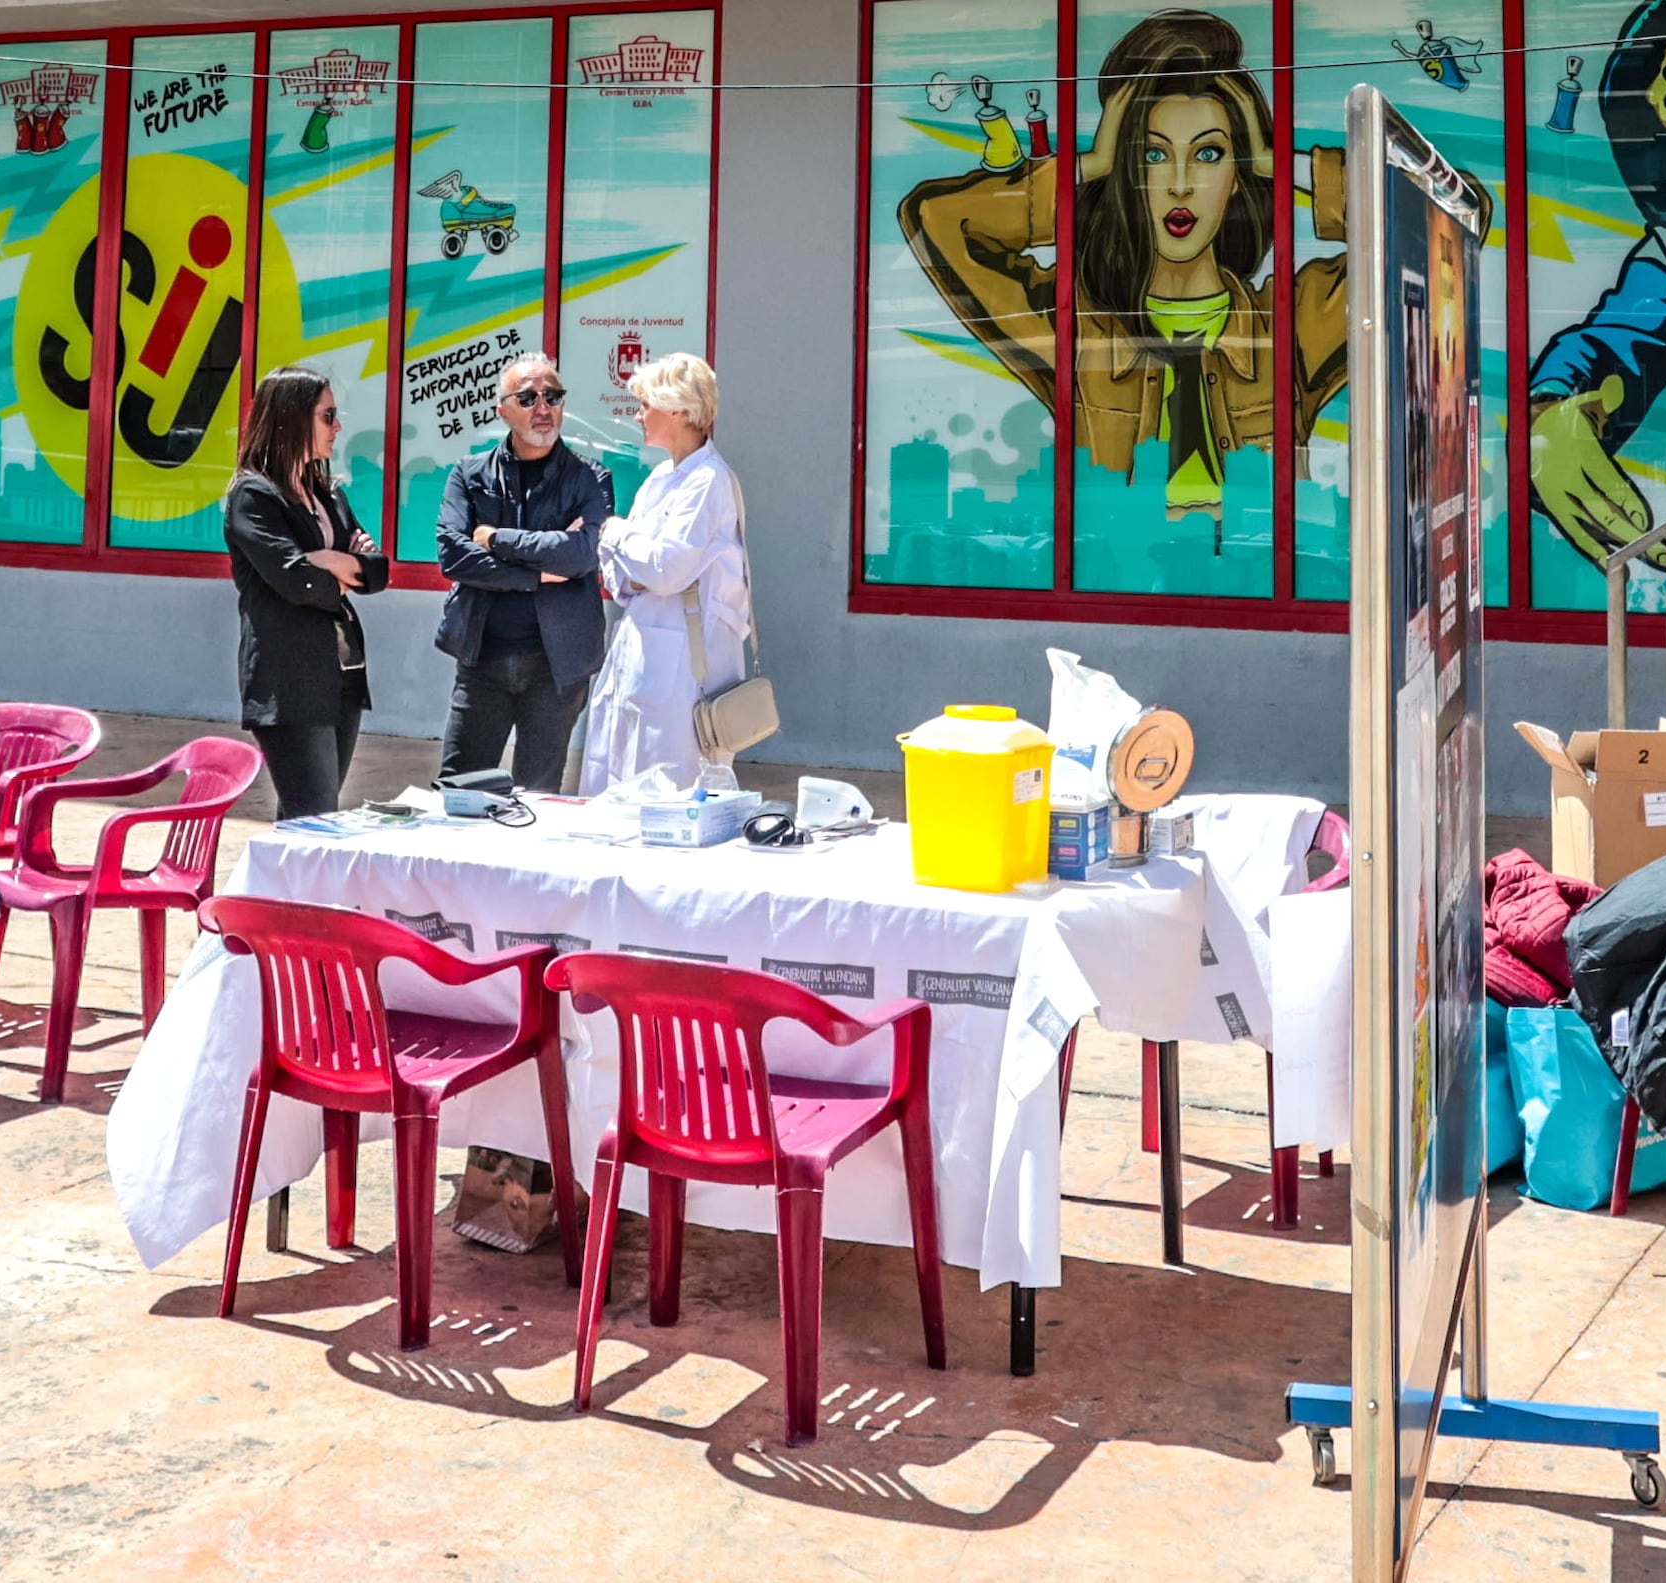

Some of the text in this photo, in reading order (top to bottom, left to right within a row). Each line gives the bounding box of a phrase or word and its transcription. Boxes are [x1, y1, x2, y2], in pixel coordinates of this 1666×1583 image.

[134, 64, 228, 112] WE ARE THE
[144, 88, 229, 137] FUTURE
[628, 317, 639, 326] de
[642, 317, 684, 326] Juventud
[406, 329, 521, 382] SERVICIO DE
[410, 349, 524, 404] INFORMACI
[436, 384, 496, 417] JUVENI
[612, 407, 623, 415] de
[438, 418, 463, 439] DE
[1638, 749, 1649, 764] 2
